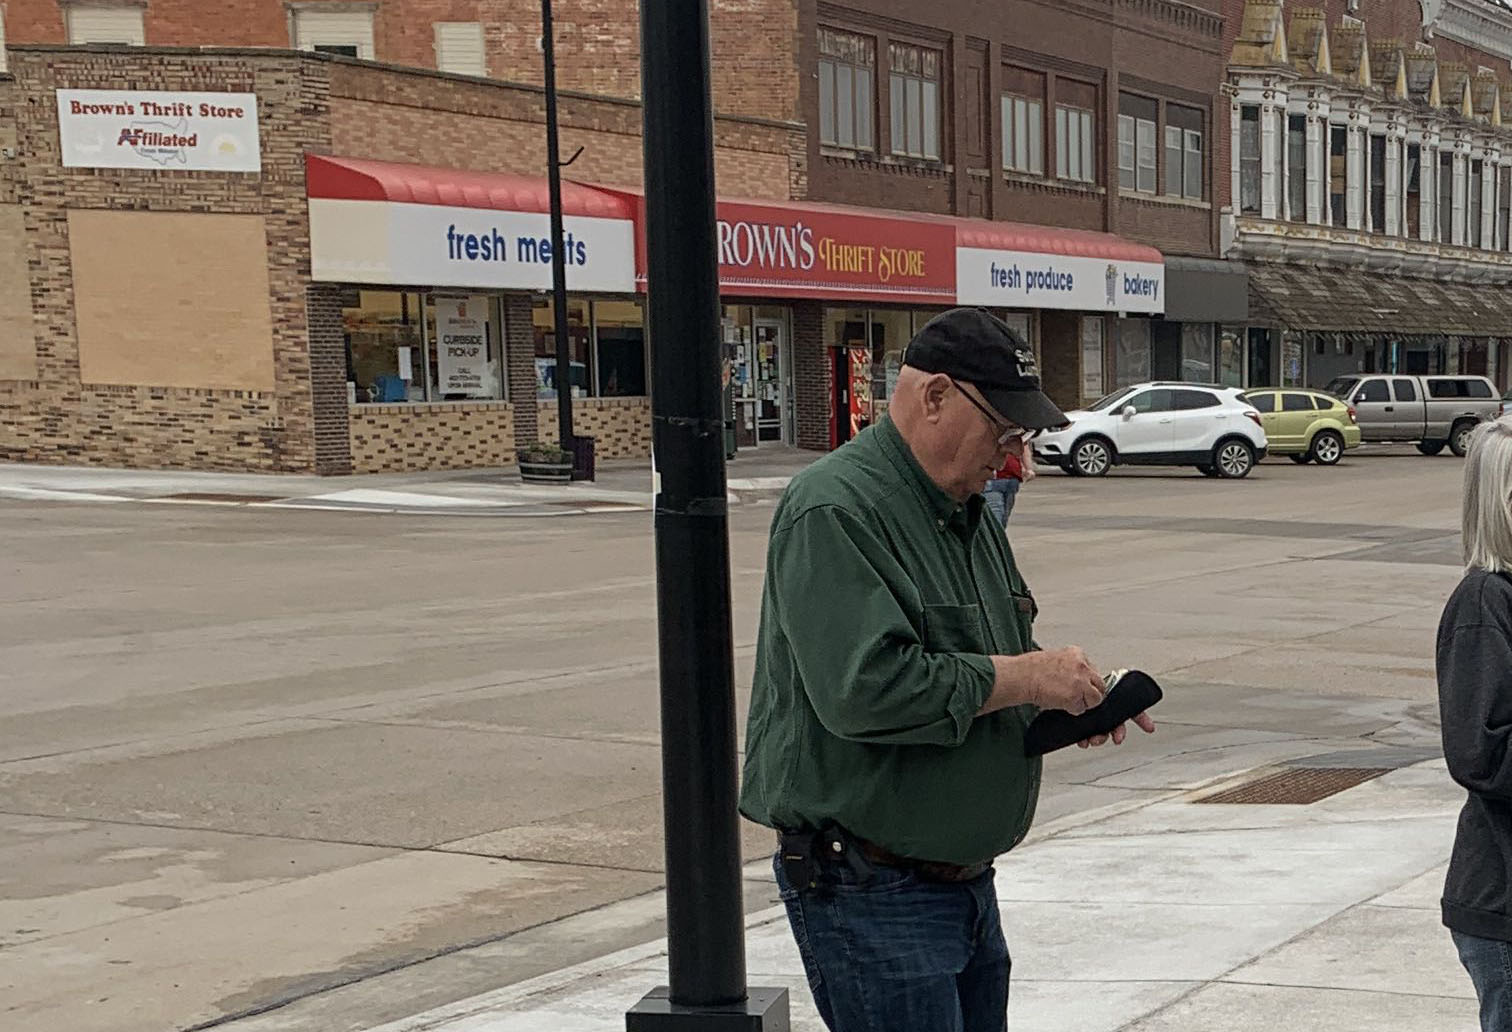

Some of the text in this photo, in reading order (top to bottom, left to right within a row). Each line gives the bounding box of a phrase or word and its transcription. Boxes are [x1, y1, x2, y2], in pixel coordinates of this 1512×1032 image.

[70, 100, 244, 118] Brown's Thrift Store
[447, 224, 587, 266] fresh mets
[716, 220, 925, 282] ROWN'S THRIFT STORE
[990, 262, 1073, 295] fresh produce
[1123, 272, 1159, 301] bakery
